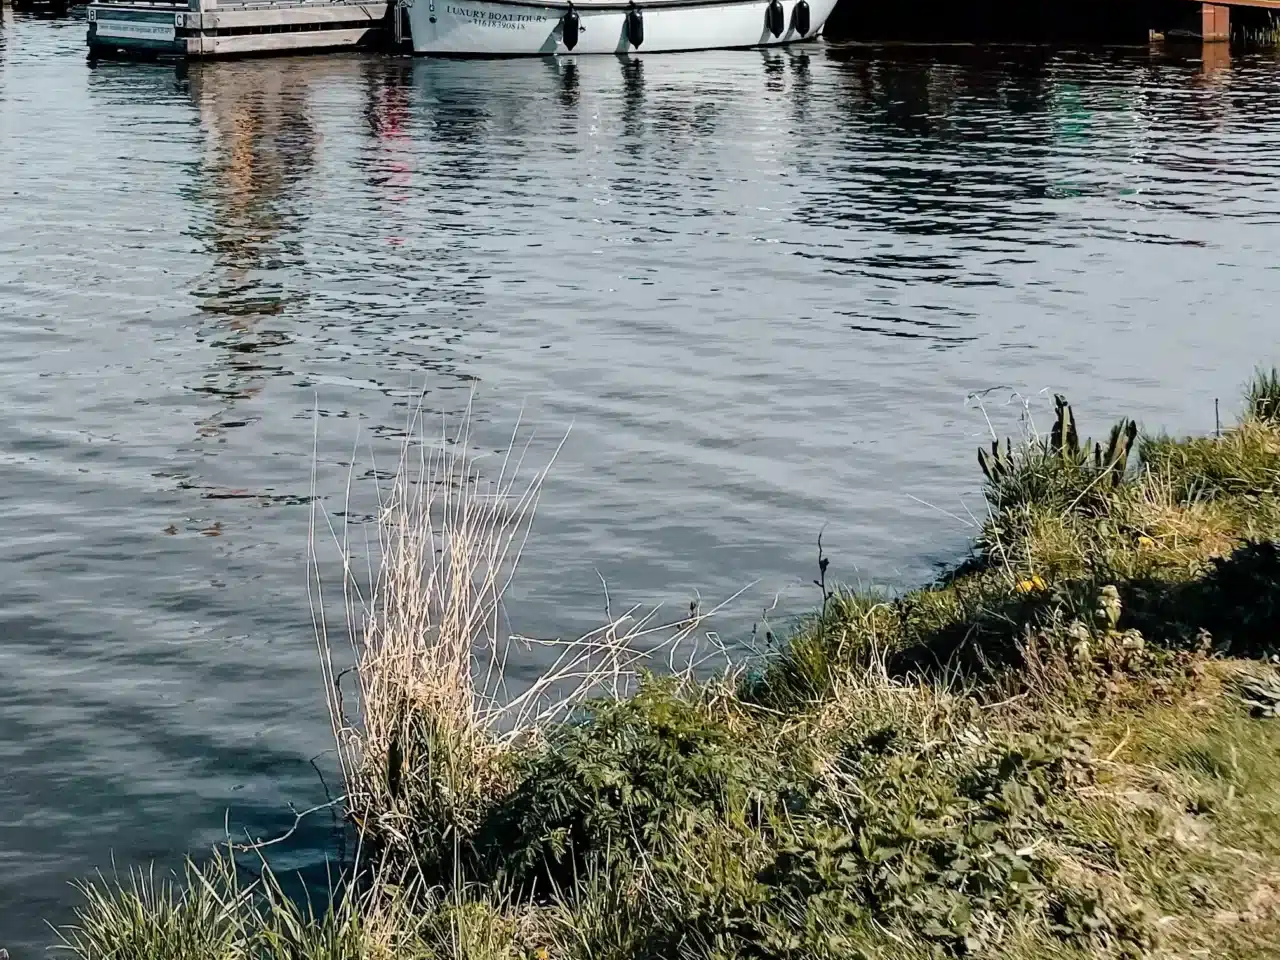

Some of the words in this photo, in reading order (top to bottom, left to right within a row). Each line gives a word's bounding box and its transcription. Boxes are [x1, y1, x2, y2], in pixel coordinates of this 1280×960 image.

[447, 6, 486, 19] LUXURY
[488, 12, 514, 22] BOAT
[517, 14, 547, 23] TOURS
